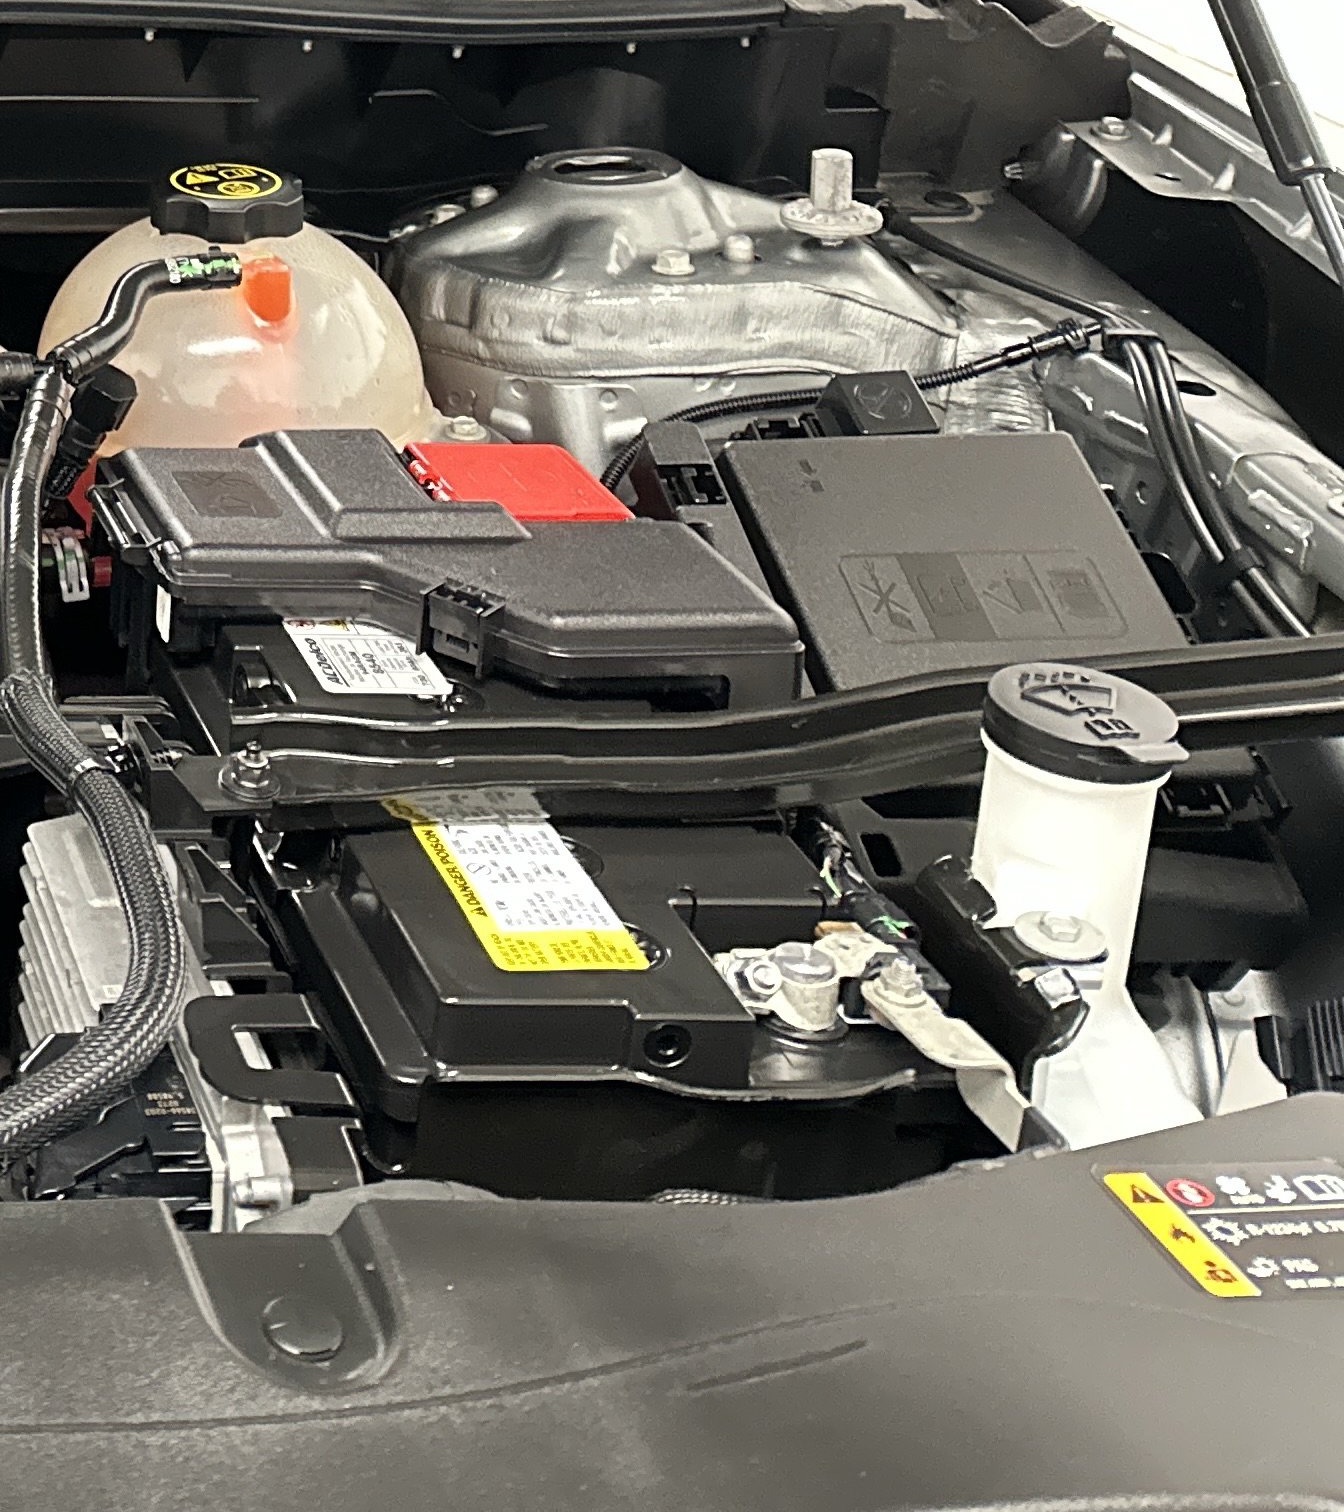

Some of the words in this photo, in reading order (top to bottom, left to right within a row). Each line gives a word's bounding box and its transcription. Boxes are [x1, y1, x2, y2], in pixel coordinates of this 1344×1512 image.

[304, 638, 343, 684] ACDelco
[422, 829, 455, 864] POISON
[445, 866, 481, 905] DANGER
